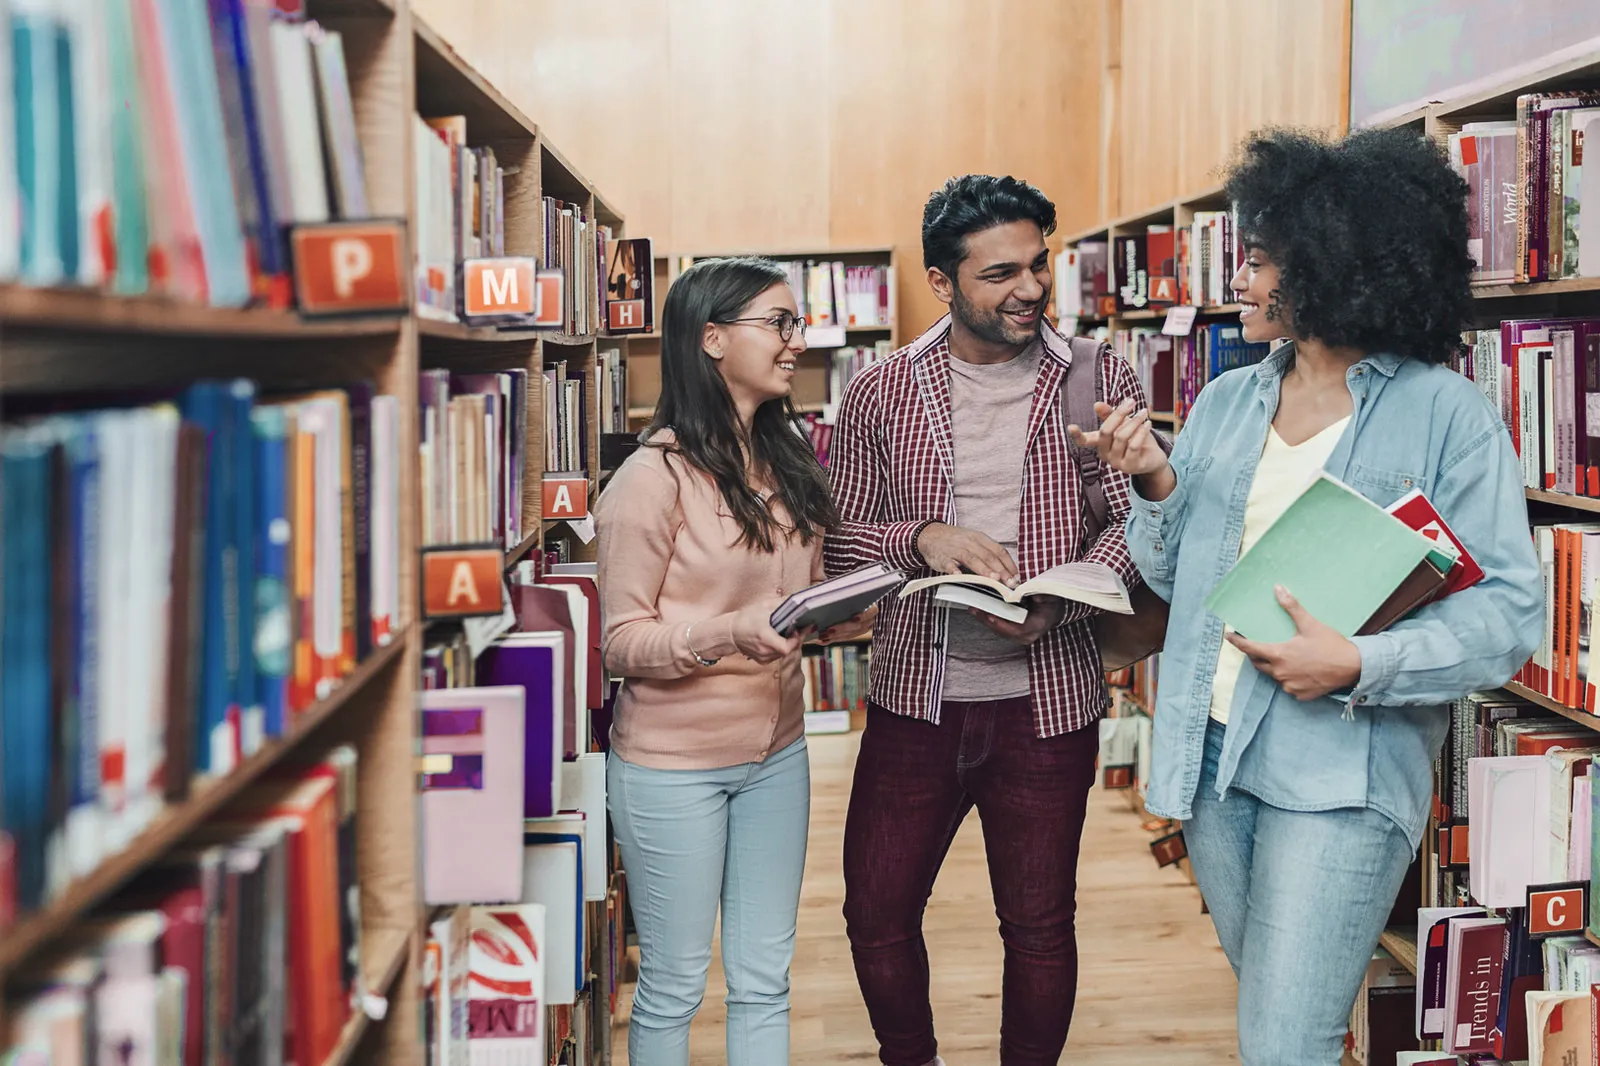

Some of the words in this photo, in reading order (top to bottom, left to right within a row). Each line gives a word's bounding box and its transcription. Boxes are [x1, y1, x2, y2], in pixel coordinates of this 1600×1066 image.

[1502, 182, 1517, 225] World
[331, 239, 374, 299] P
[481, 267, 519, 306] M
[1156, 280, 1170, 298] A
[619, 304, 634, 326] H
[551, 484, 574, 513] A
[446, 560, 481, 607] A
[1546, 896, 1566, 927] C
[1469, 955, 1491, 975] in
[1466, 980, 1490, 1041] Trends
